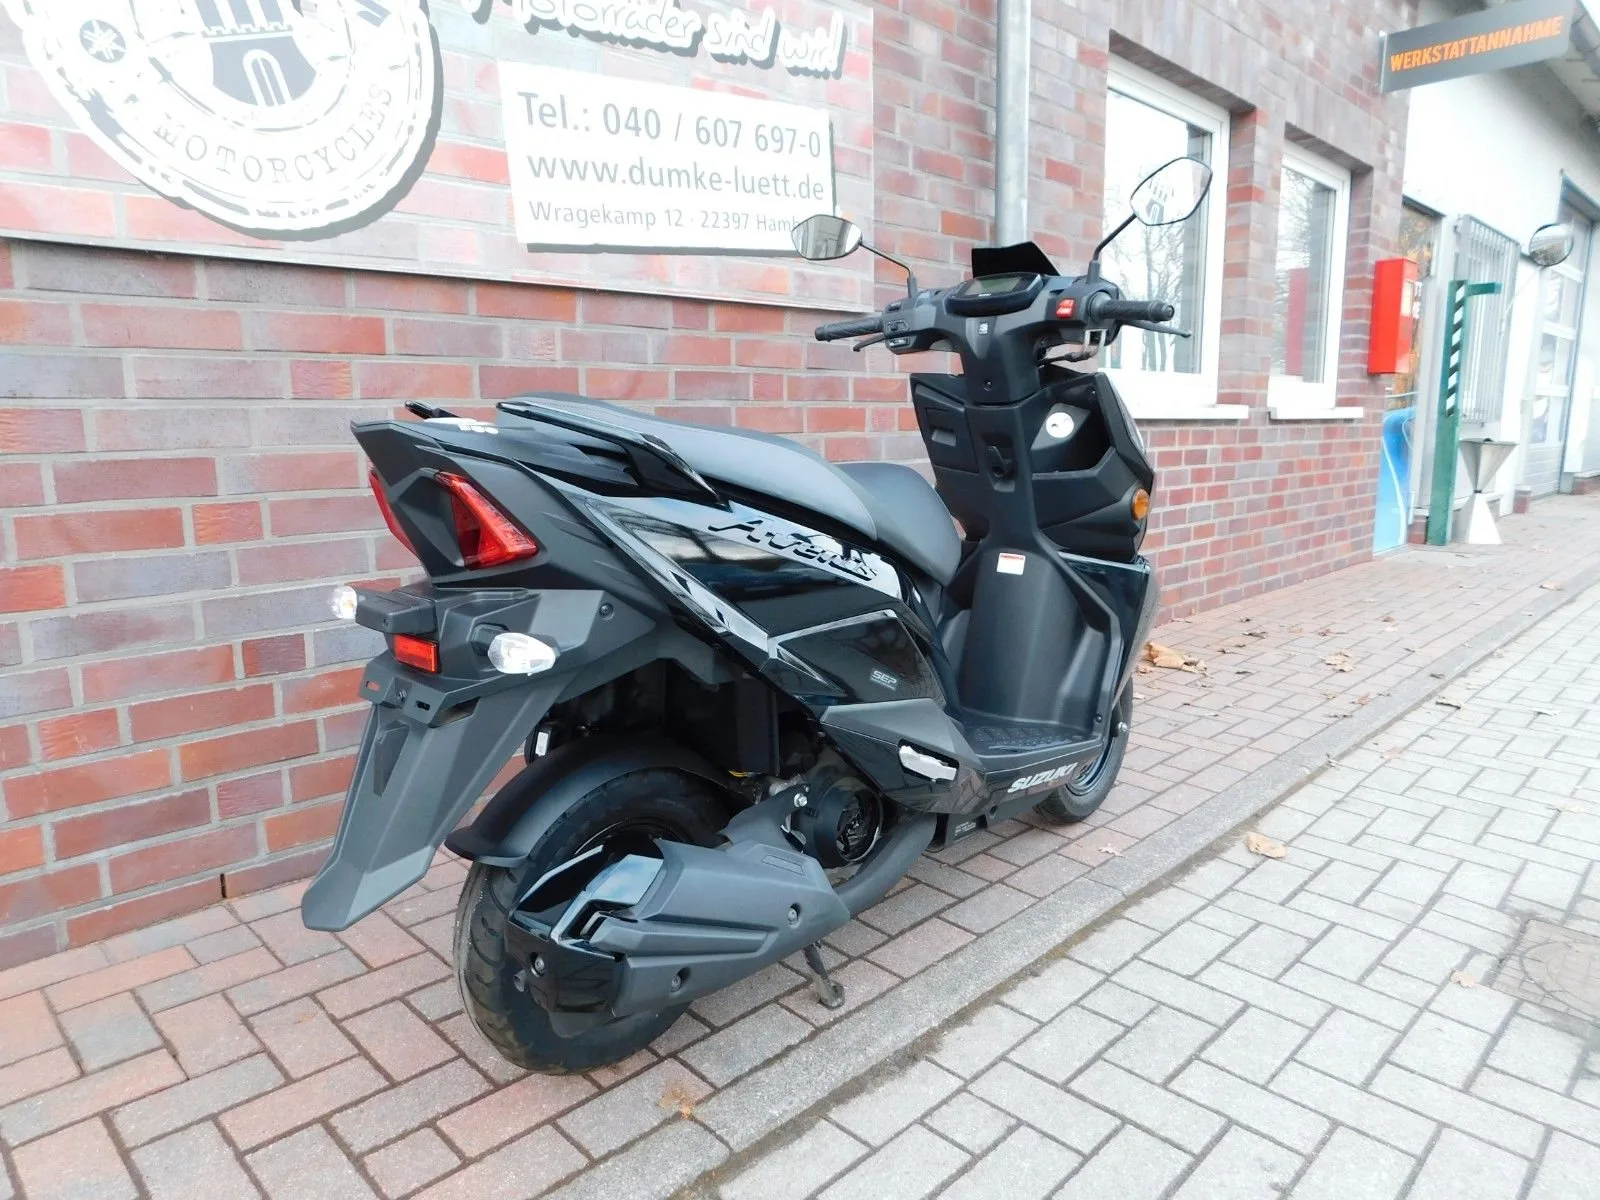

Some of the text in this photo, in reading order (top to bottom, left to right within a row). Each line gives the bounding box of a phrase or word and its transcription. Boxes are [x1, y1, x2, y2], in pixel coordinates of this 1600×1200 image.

[468, 0, 698, 44] otorräder
[706, 12, 774, 57] sind
[1390, 15, 1564, 72] WERKSTATTANNAHME
[517, 92, 821, 158] Tel.: 040 / 607 697-0
[527, 154, 825, 201] www.dumke-luett.de
[529, 200, 656, 230] Wragekamp
[664, 208, 683, 227] 12
[701, 210, 750, 231] 22397
[871, 670, 897, 684] SEP
[1007, 762, 1079, 793] SUZUKI
